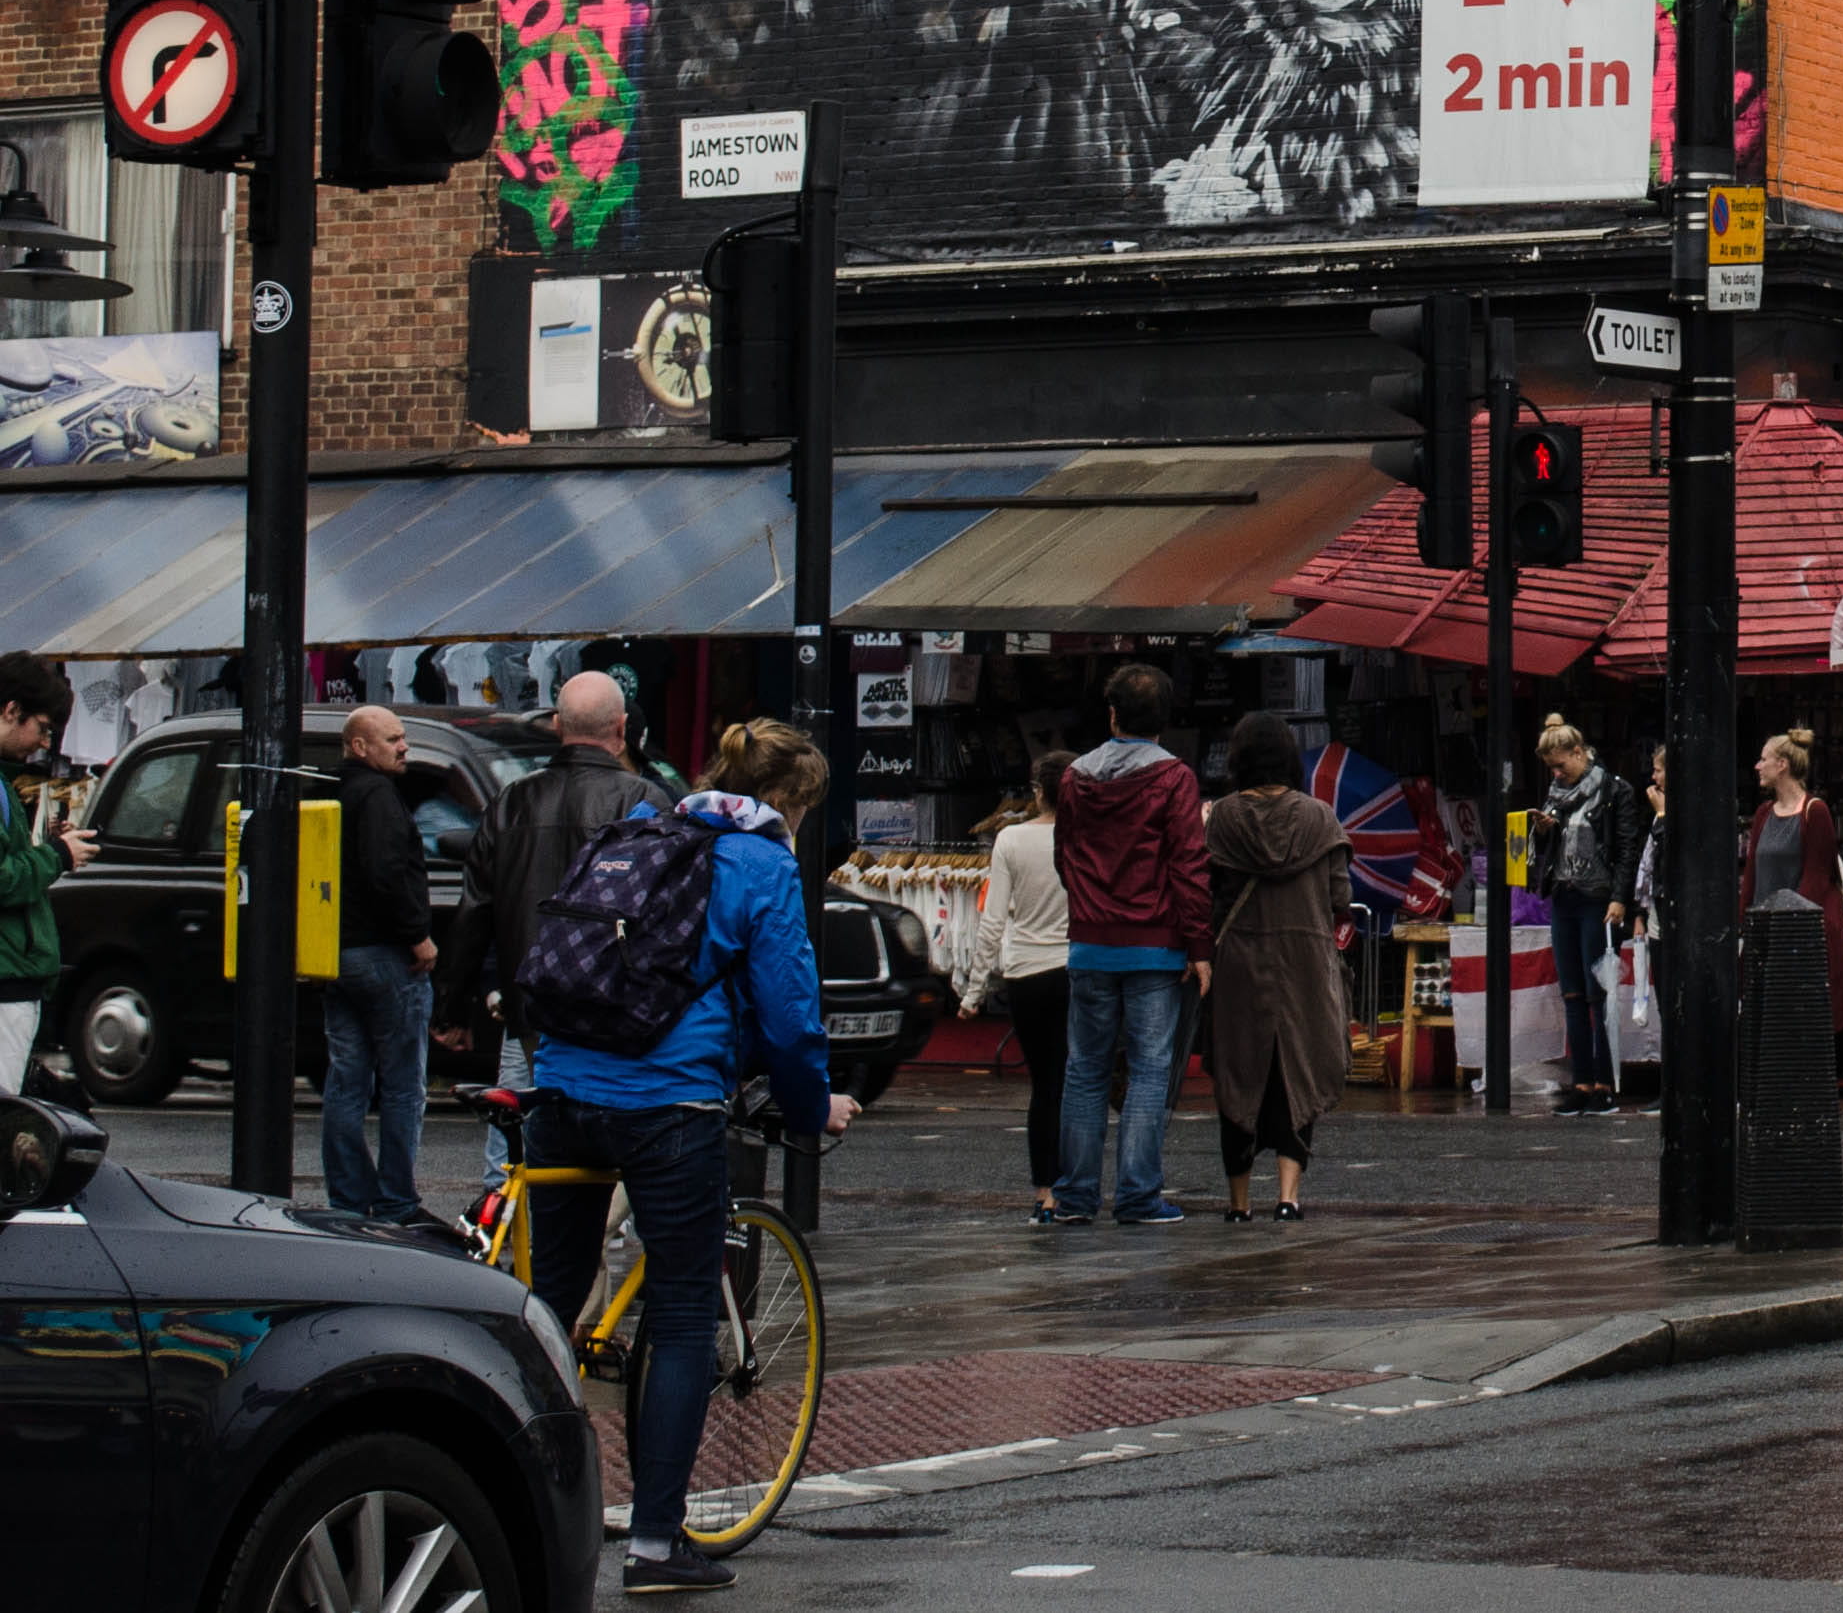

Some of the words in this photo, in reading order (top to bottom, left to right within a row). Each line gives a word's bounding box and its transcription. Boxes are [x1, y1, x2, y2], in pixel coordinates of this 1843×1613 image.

[1443, 52, 1484, 113] 2
[1499, 46, 1631, 110] min
[688, 133, 798, 159] JAMESTOWN
[689, 167, 740, 188] ROAD
[775, 170, 799, 182] NW1
[1740, 216, 1756, 229] Zone
[1721, 272, 1731, 285] No
[1720, 291, 1729, 304] at
[1730, 292, 1742, 305] any
[1610, 323, 1675, 355] TOILET
[866, 677, 907, 695] ARCTIC
[861, 689, 909, 704] MONKEYS
[861, 816, 912, 830] London
